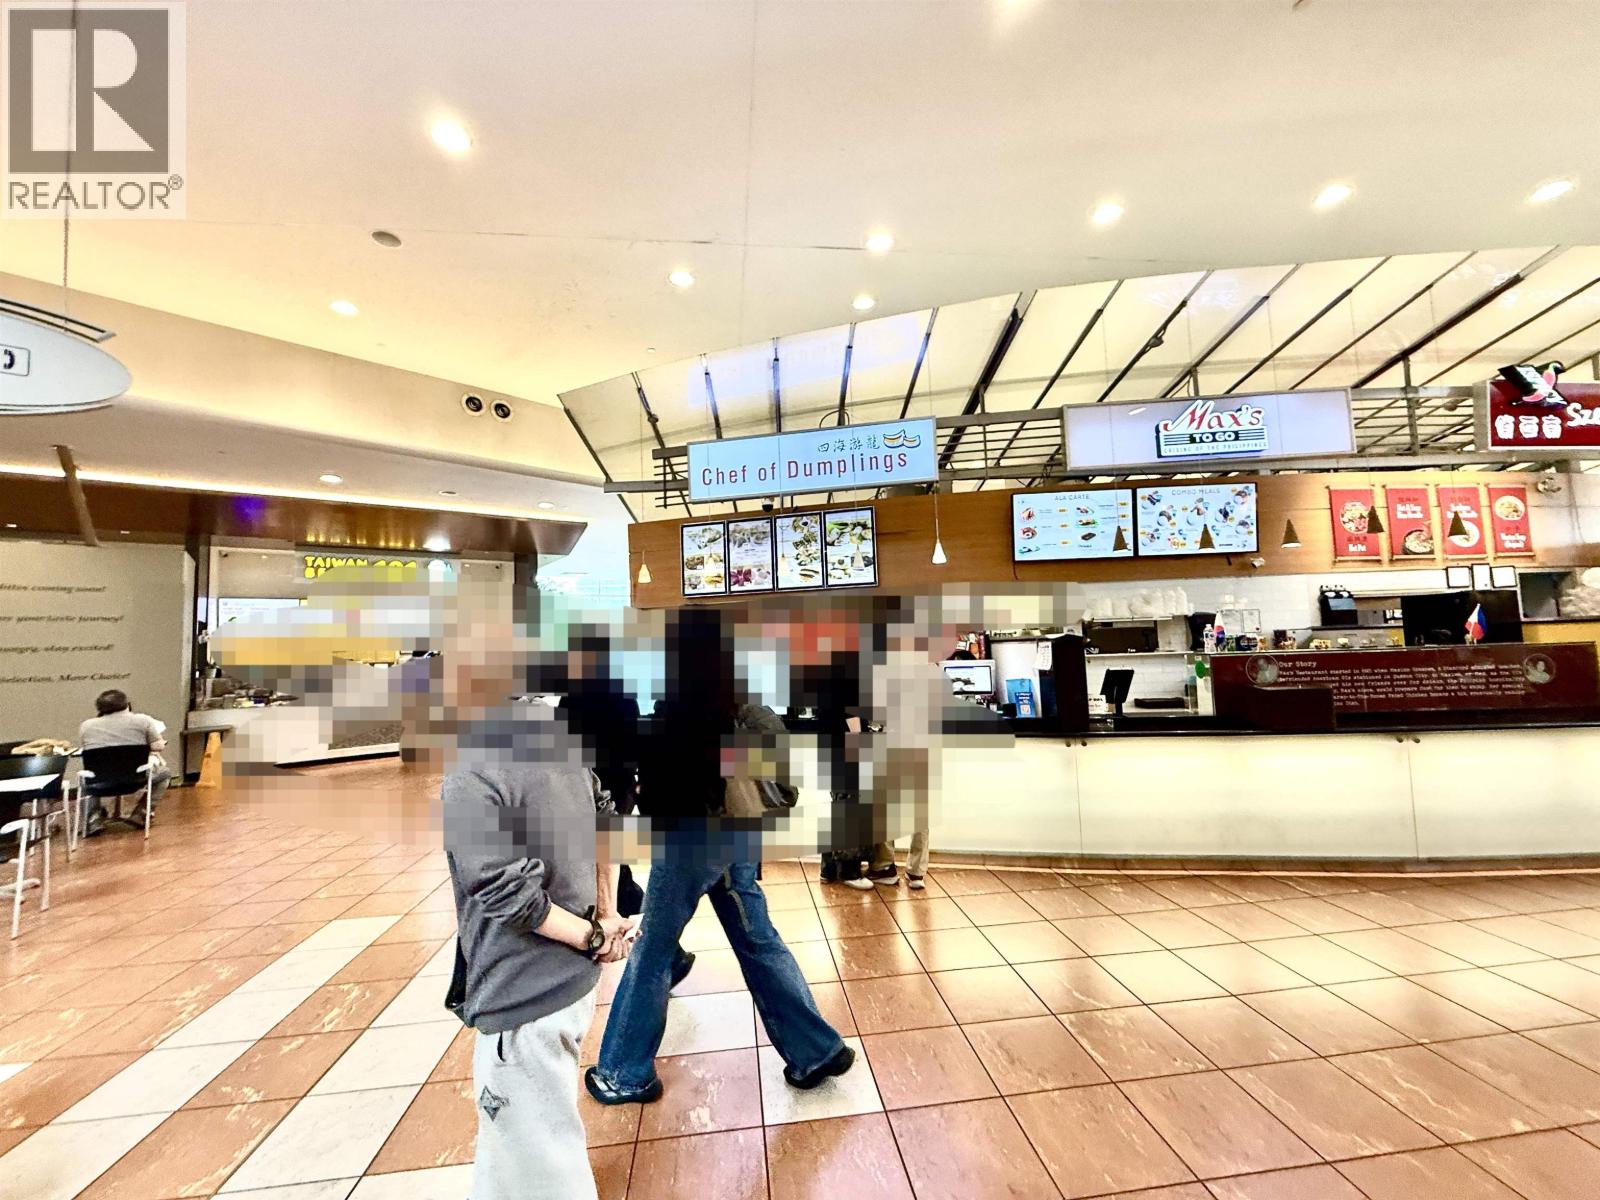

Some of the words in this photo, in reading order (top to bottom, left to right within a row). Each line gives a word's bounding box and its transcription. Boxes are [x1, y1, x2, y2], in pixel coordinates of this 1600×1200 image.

[1163, 401, 1263, 432] Max's
[1193, 432, 1213, 443] TO
[1215, 431, 1236, 442] GO
[702, 464, 747, 486] Chef
[758, 462, 777, 481] of
[787, 451, 908, 478] Dumplings
